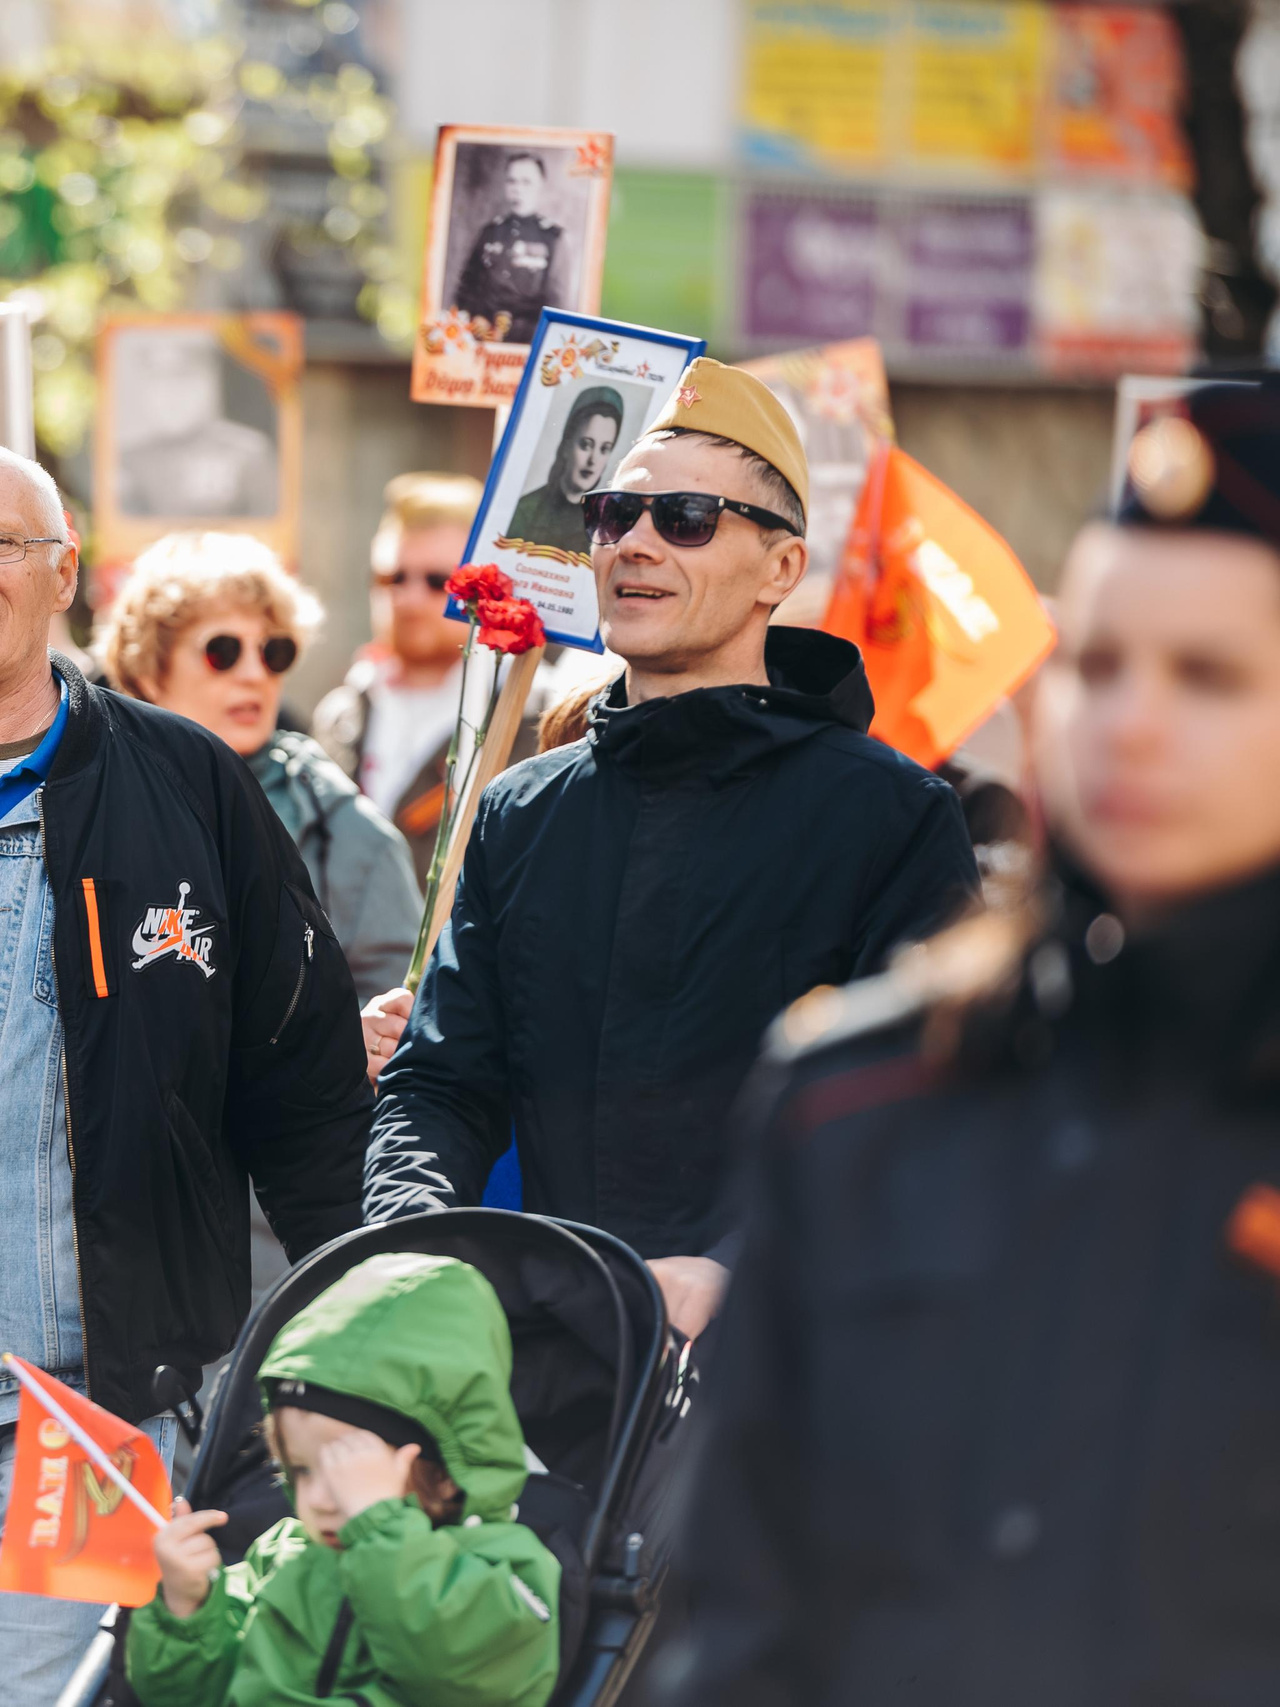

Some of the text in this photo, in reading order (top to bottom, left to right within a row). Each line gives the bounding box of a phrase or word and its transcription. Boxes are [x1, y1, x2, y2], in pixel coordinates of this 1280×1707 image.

[530, 582, 575, 599] Ивановна
[142, 907, 195, 935] NIKE
[176, 936, 212, 962] AIR
